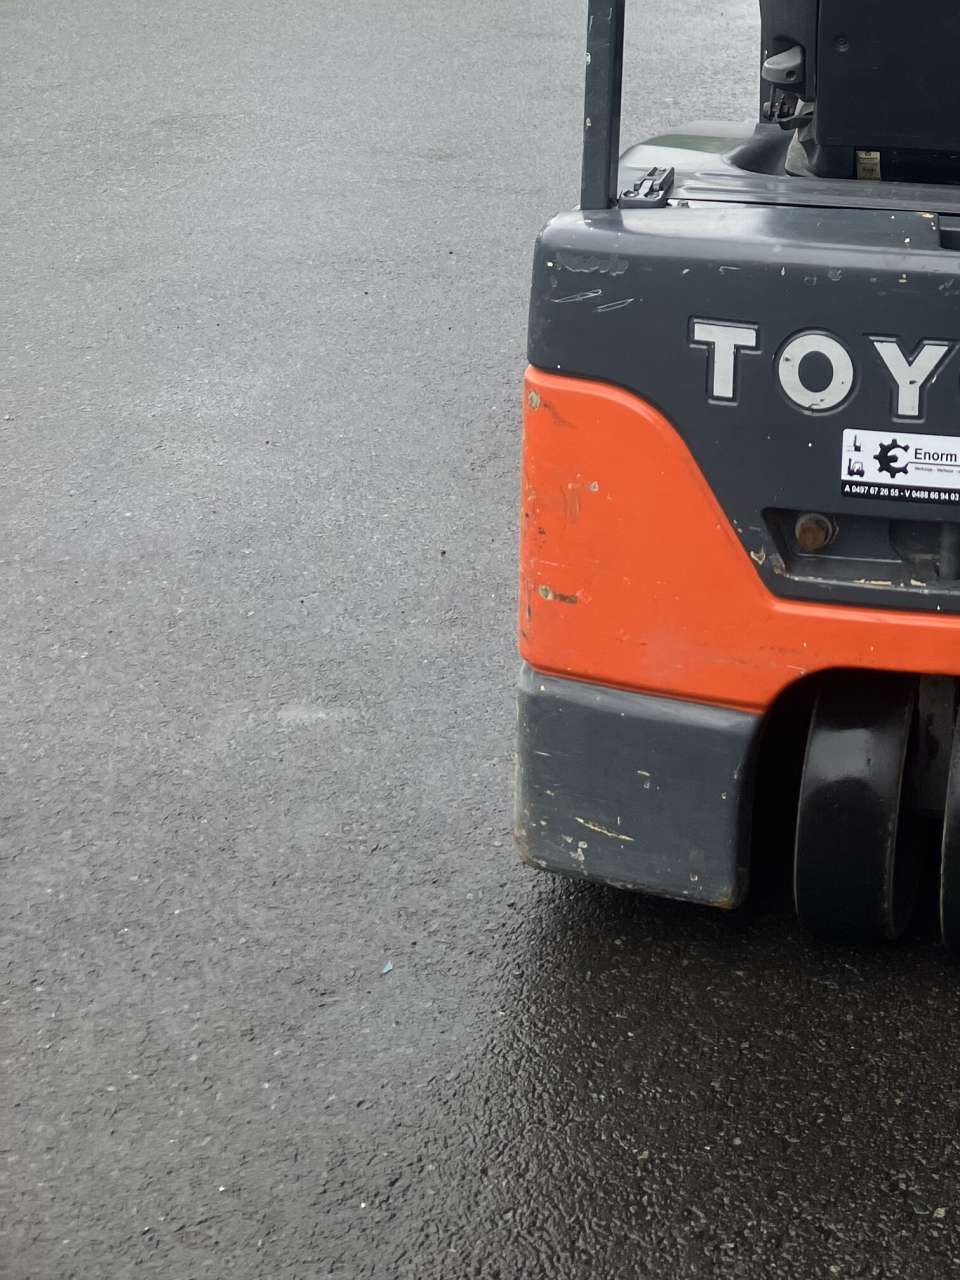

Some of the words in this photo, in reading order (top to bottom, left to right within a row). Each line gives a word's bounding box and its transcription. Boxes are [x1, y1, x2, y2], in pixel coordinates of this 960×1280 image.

[914, 447, 957, 462] Enorm
[844, 484, 850, 492] A
[904, 488, 910, 498] V
